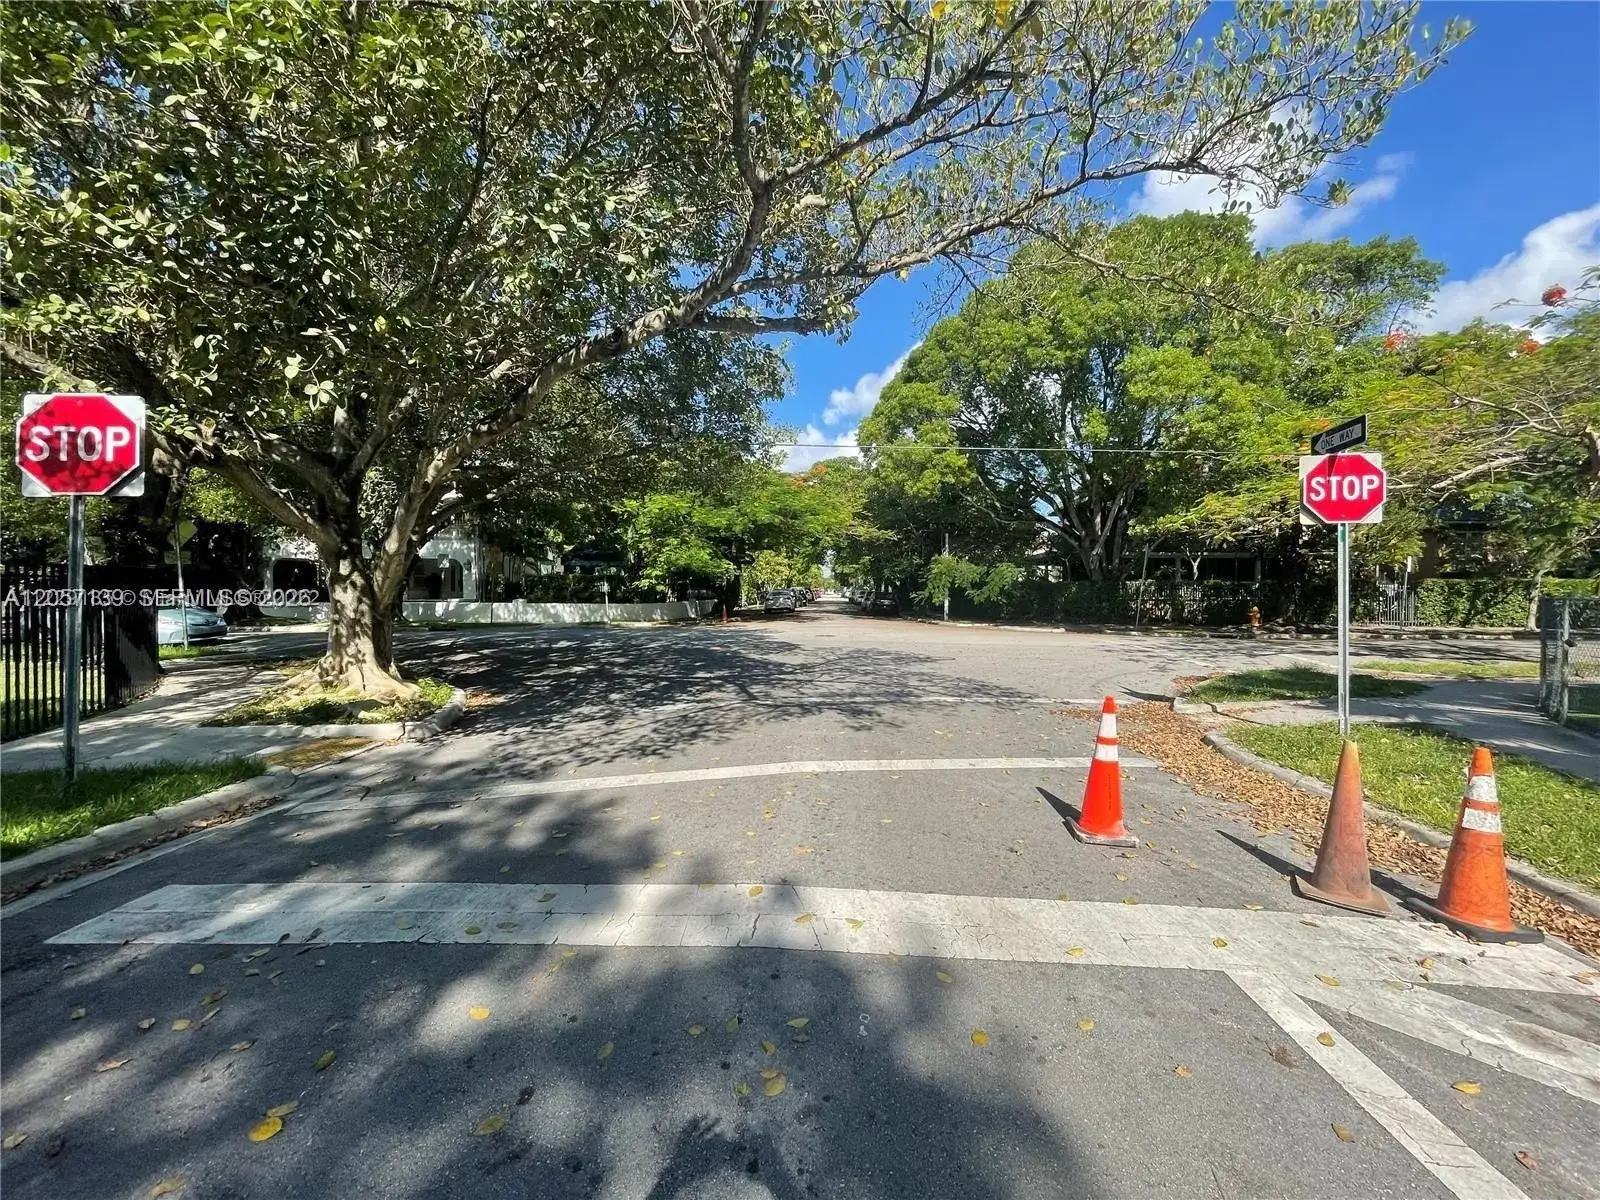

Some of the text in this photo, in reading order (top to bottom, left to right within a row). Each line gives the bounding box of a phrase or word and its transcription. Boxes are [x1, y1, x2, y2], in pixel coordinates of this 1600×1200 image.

[25, 424, 131, 462] STOP
[1320, 427, 1354, 450] ONE WAY
[1309, 474, 1379, 501] STOP
